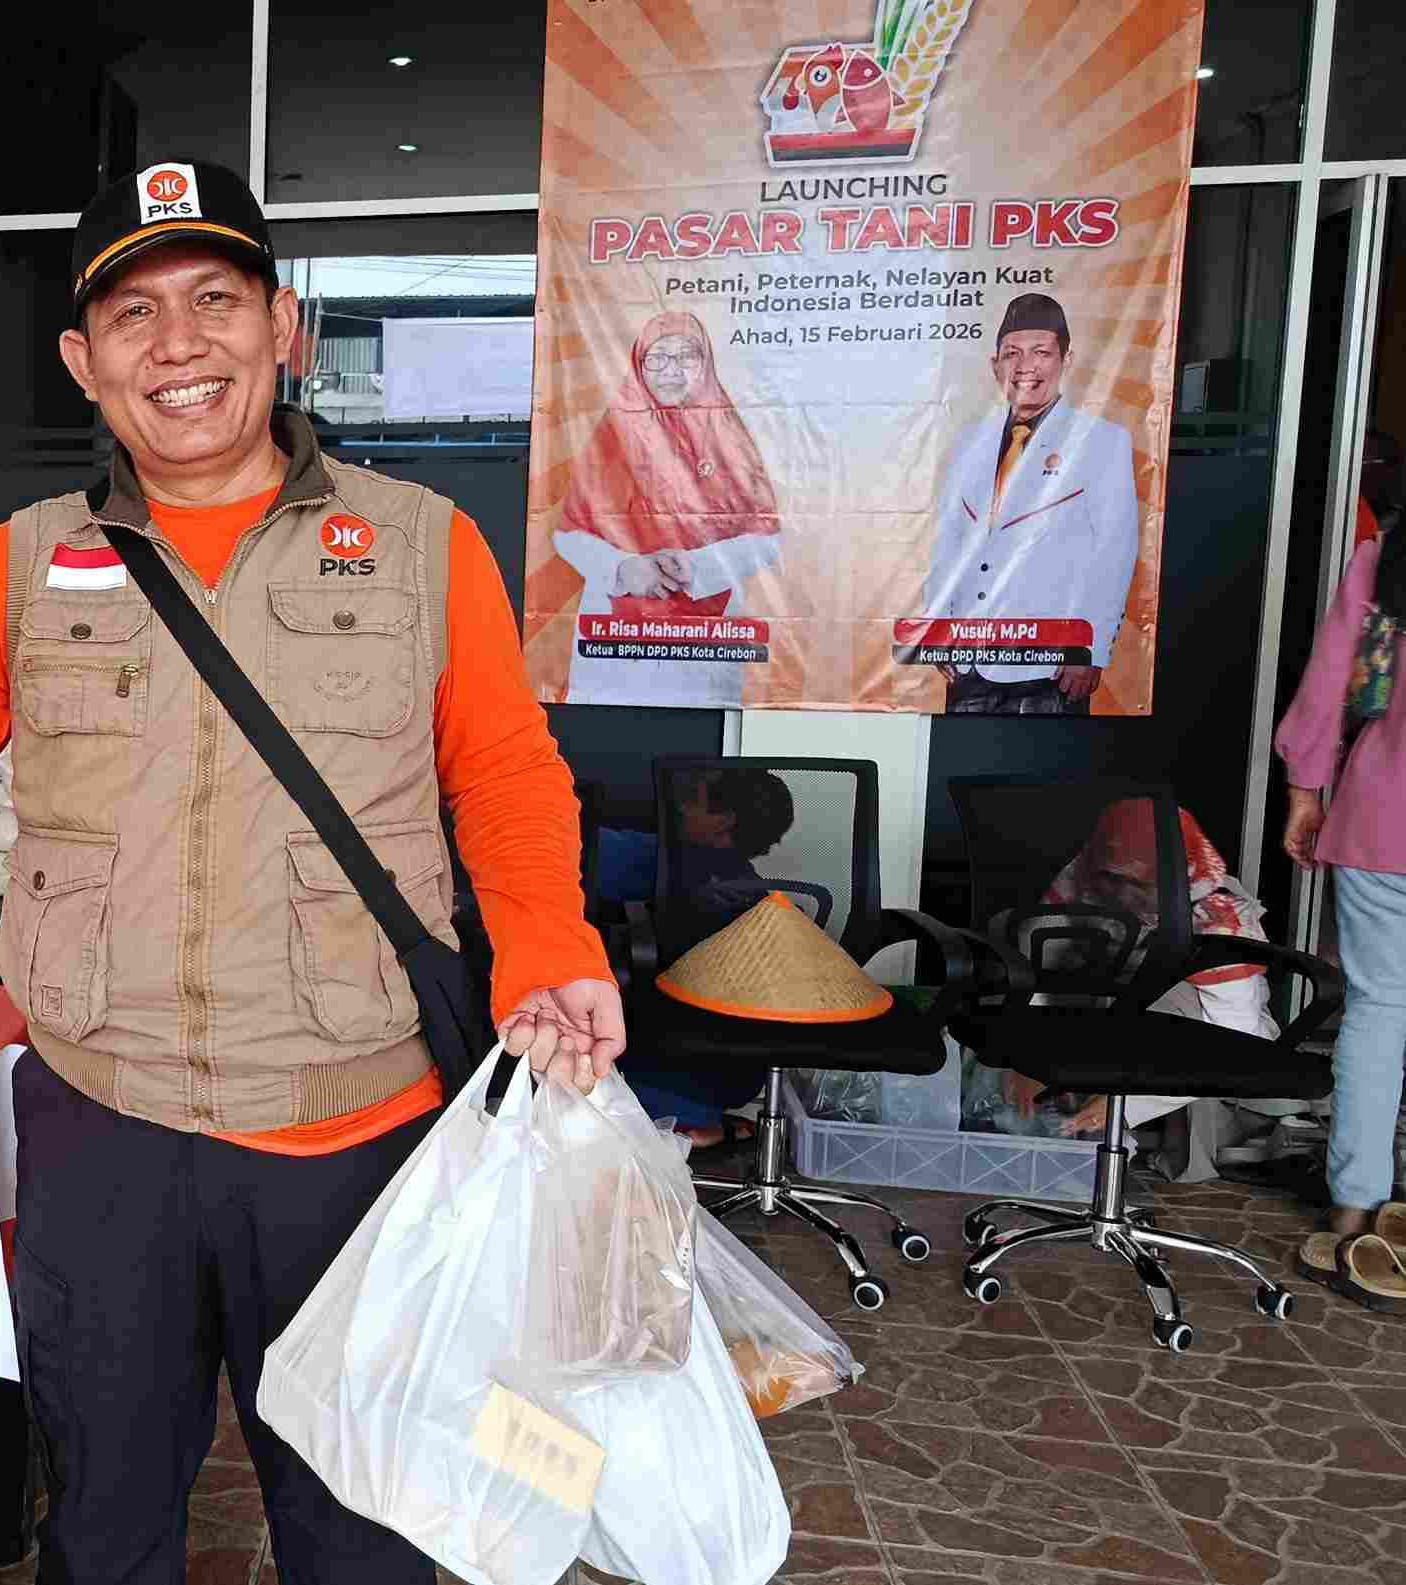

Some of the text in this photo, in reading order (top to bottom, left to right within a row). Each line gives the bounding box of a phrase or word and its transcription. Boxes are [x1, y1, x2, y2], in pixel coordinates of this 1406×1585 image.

[760, 174, 947, 202] LAUNCHING
[147, 202, 193, 218] PKS
[590, 199, 1120, 263] PASAR TANI PKS
[665, 267, 1054, 295] Petani, Peternak, Nelayan Kuat
[730, 290, 984, 313] Indonesia Berdaulat
[730, 323, 983, 347] Ahad, 15 Februari 2026
[319, 558, 376, 576] PKS
[591, 620, 755, 639] Ir. Risa Maharani Alissa
[950, 623, 1037, 641] Yusuf, M.Pd
[585, 643, 756, 660] Ketua BPPN DPD PKS Kota Cirebon
[920, 650, 1065, 662] Ketua DPD PKS Kota Cirebon
